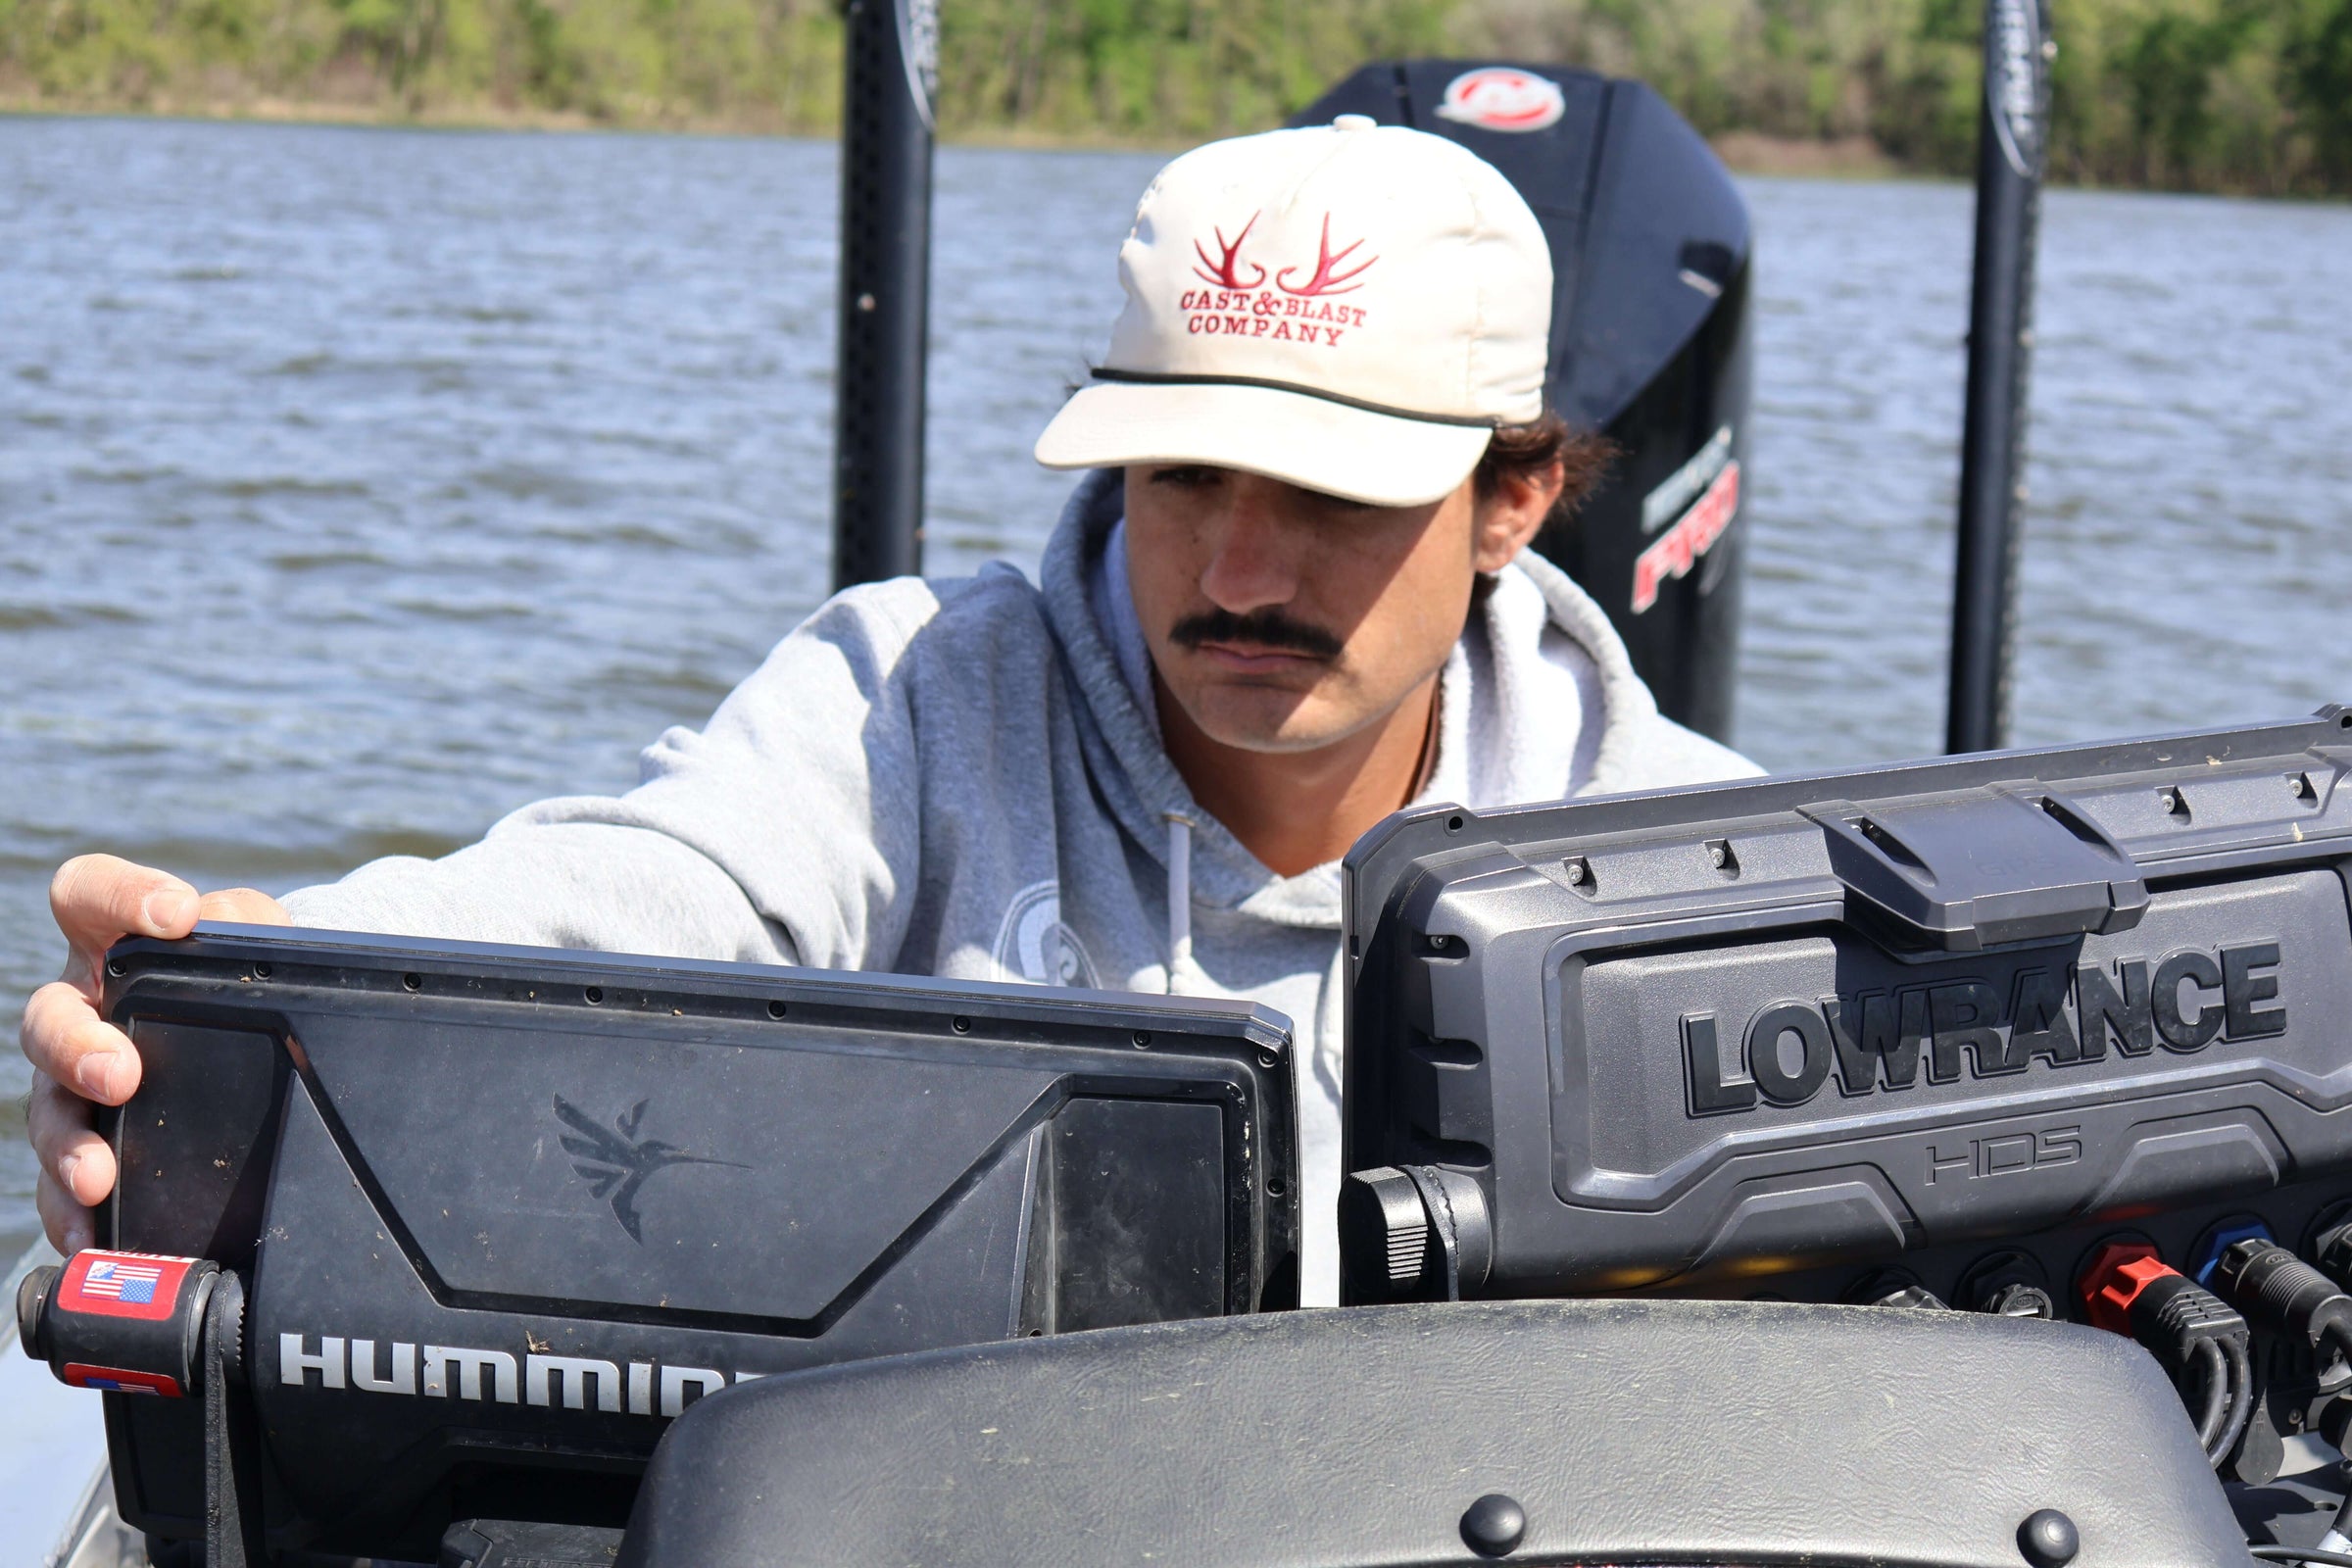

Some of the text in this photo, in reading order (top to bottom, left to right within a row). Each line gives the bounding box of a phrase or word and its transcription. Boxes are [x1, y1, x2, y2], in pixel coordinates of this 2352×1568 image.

[1188, 315, 1344, 346] COMPANY
[1681, 940, 2286, 1116] LOWRANCE
[1925, 1125, 2082, 1187] HDS
[280, 1333, 767, 1417] HUMMIN
